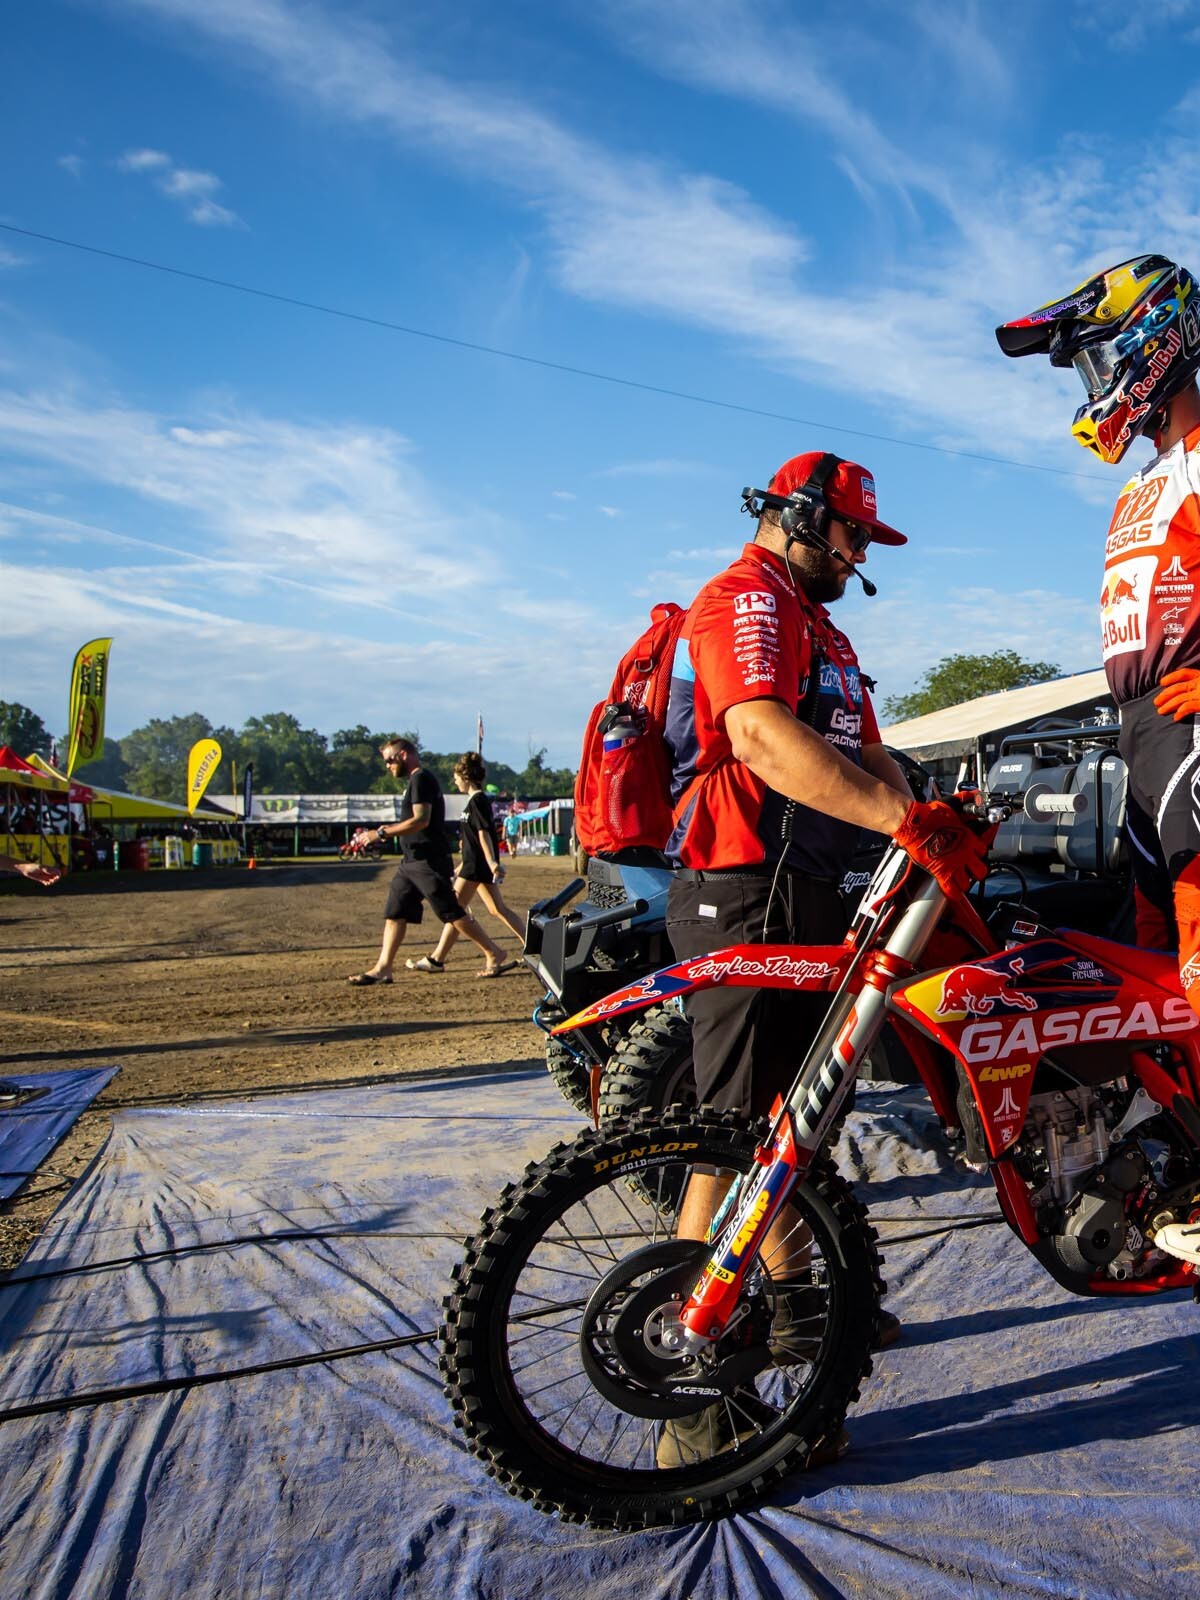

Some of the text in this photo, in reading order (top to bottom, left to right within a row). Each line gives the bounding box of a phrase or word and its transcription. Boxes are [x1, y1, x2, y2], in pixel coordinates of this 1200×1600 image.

[1131, 327, 1182, 402] Red Bull
[1106, 523, 1154, 556] ASGAS
[1154, 584, 1195, 592] METHOD
[735, 593, 775, 610] PPG
[733, 614, 779, 627] METHOD
[1110, 612, 1142, 647] Bull
[688, 955, 840, 986] Troy Lee Designs
[1071, 968, 1104, 981] PICTURES
[1076, 961, 1095, 972] SONY
[958, 996, 1200, 1064] GASGAS
[592, 1141, 700, 1176] DUNLOP
[670, 1385, 722, 1397] ACERBIS
